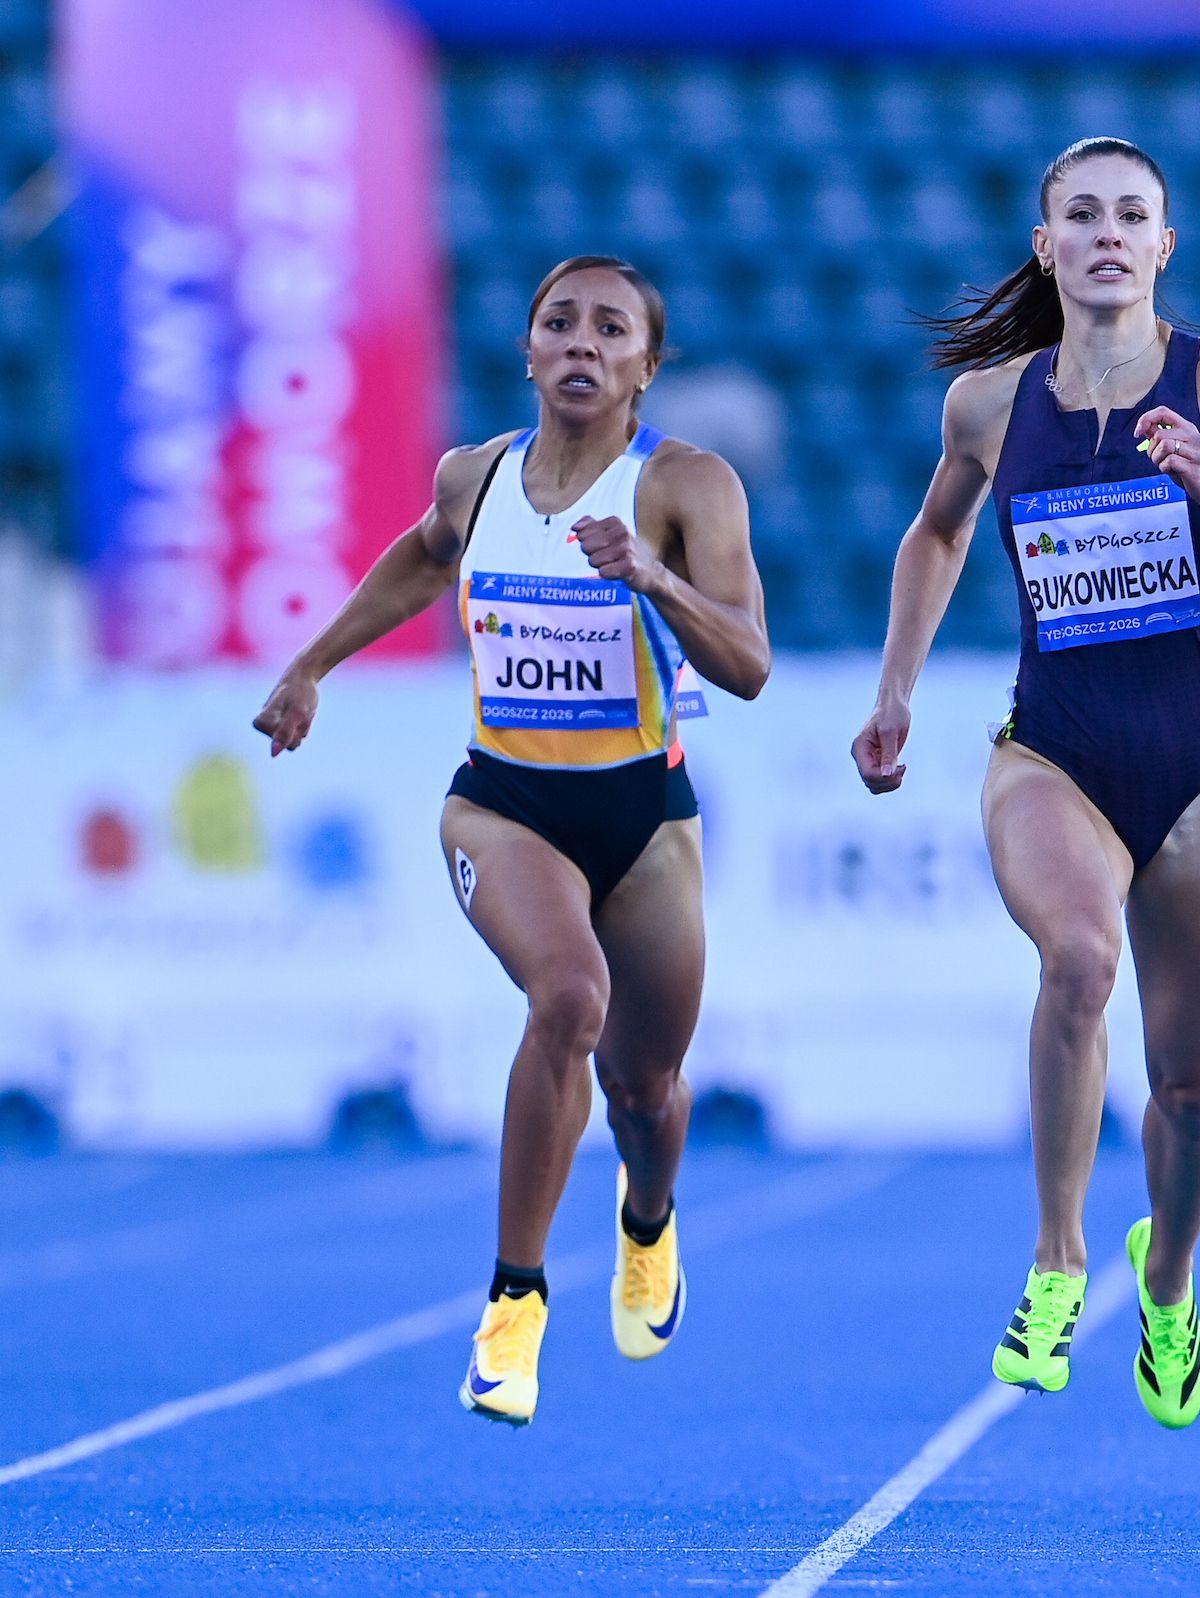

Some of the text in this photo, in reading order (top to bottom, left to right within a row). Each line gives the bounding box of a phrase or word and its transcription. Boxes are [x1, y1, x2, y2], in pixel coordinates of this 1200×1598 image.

[1047, 486, 1170, 514] IRENY SZEWIŃSKIEJ
[1074, 526, 1180, 553] BYDGOSZCZ
[502, 585, 617, 604] IRENY SZEWIŃSKIEJ
[1028, 556, 1196, 612] BUKOWIECKA
[520, 624, 622, 643] BYDGOSZCZ
[1109, 618, 1140, 631] 2026
[496, 656, 603, 692] JOHN
[541, 708, 574, 720] 2026
[460, 860, 472, 895] 6
